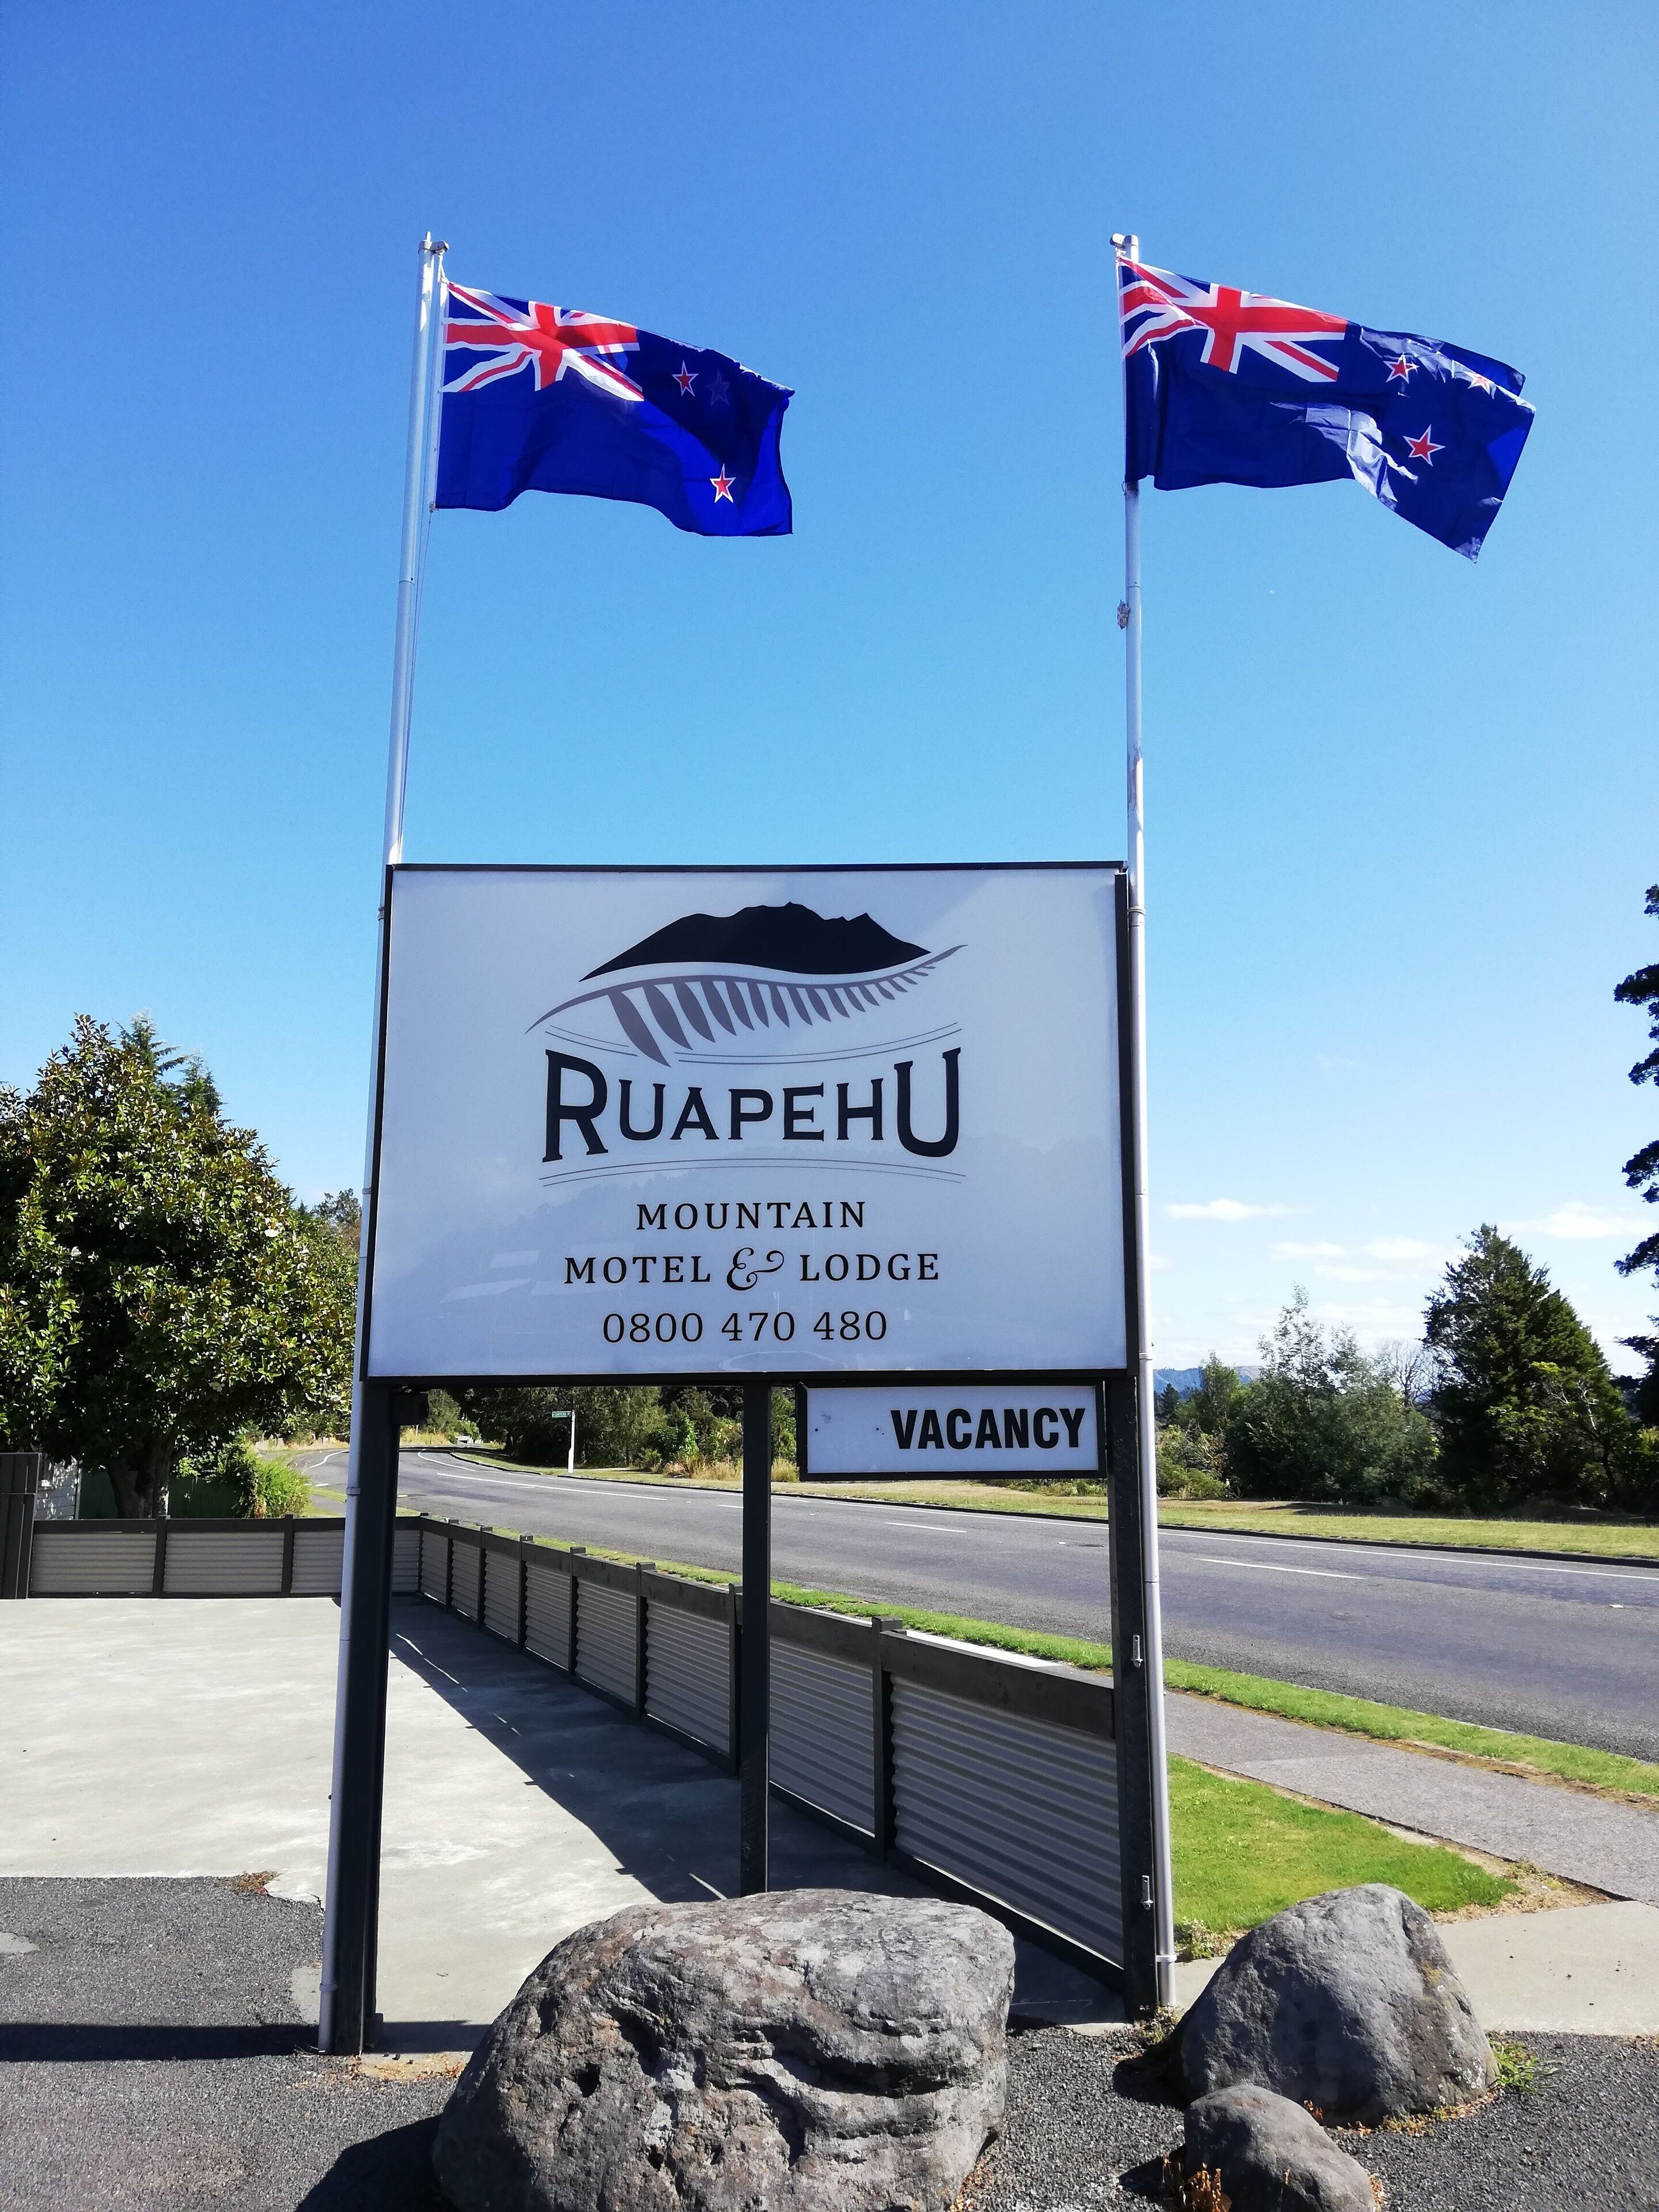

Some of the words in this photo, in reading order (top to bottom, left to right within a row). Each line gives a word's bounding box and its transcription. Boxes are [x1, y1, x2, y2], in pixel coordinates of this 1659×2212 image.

[542, 1047, 961, 1164] RUAPEHU
[636, 1201, 866, 1230] MOUNTAIN
[564, 1256, 711, 1284] MOTEL
[726, 1247, 785, 1291] &
[800, 1253, 938, 1281] LODGE
[603, 1312, 703, 1343] 0800
[721, 1312, 795, 1342] 470
[813, 1310, 887, 1340] 480
[890, 1407, 1086, 1450] VACANCY
